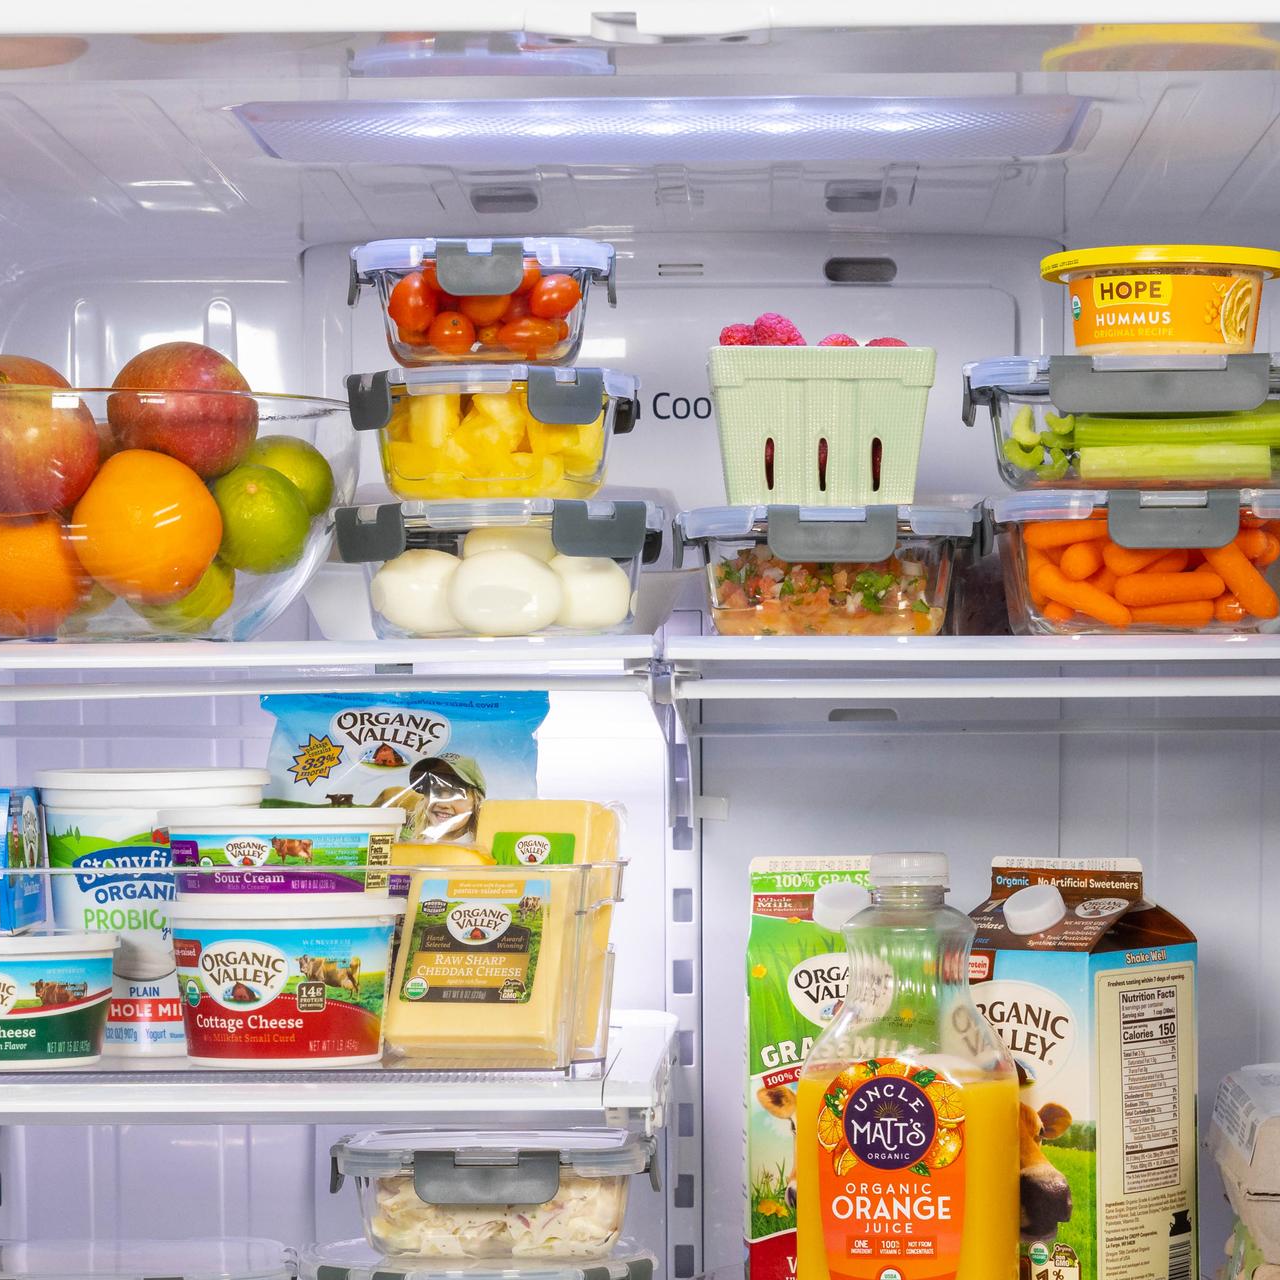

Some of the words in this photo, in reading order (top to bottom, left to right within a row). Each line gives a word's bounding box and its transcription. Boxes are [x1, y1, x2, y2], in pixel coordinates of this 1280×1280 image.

[1100, 281, 1162, 300] HOPE
[1096, 312, 1171, 326] HUMMUS
[1094, 329, 1134, 338] ORIGINAL
[1138, 328, 1174, 336] RECIPE
[337, 711, 445, 739] ORGANIC
[345, 726, 433, 752] VALLEY
[226, 842, 267, 853] ORGANIC
[518, 840, 549, 850] ORGANIC
[520, 847, 544, 856] VALLEY
[231, 849, 262, 860] VALLEY
[214, 873, 243, 883] Sour
[245, 873, 285, 883] Cream
[996, 876, 1029, 887] Organic
[1038, 878, 1049, 887] No
[1050, 878, 1088, 887] Artificial
[1089, 879, 1138, 890] Sweeteners
[451, 909, 509, 922] ORGANIC
[455, 919, 502, 930] VALLEY
[201, 952, 285, 973] ORGANIC
[1126, 951, 1149, 964] Shake
[1150, 949, 1166, 961] Well
[209, 967, 276, 988] VALLEY
[129, 986, 160, 997] PLAIN
[301, 987, 323, 997] 14g
[1122, 991, 1155, 1003] Nutrition
[1157, 990, 1175, 999] Facts
[197, 1014, 243, 1034] Cottage
[247, 1015, 304, 1028] Cheese
[1123, 1029, 1154, 1040] Calories
[1159, 1022, 1175, 1036] 150
[5, 1042, 27, 1050] Flavor
[854, 1084, 924, 1113] UNCLE
[851, 1117, 926, 1151] MATT'S
[846, 1182, 932, 1195] ORGANIC
[831, 1196, 951, 1220] ORANGE
[864, 1223, 913, 1234] JUICE
[854, 1240, 868, 1248] ONE
